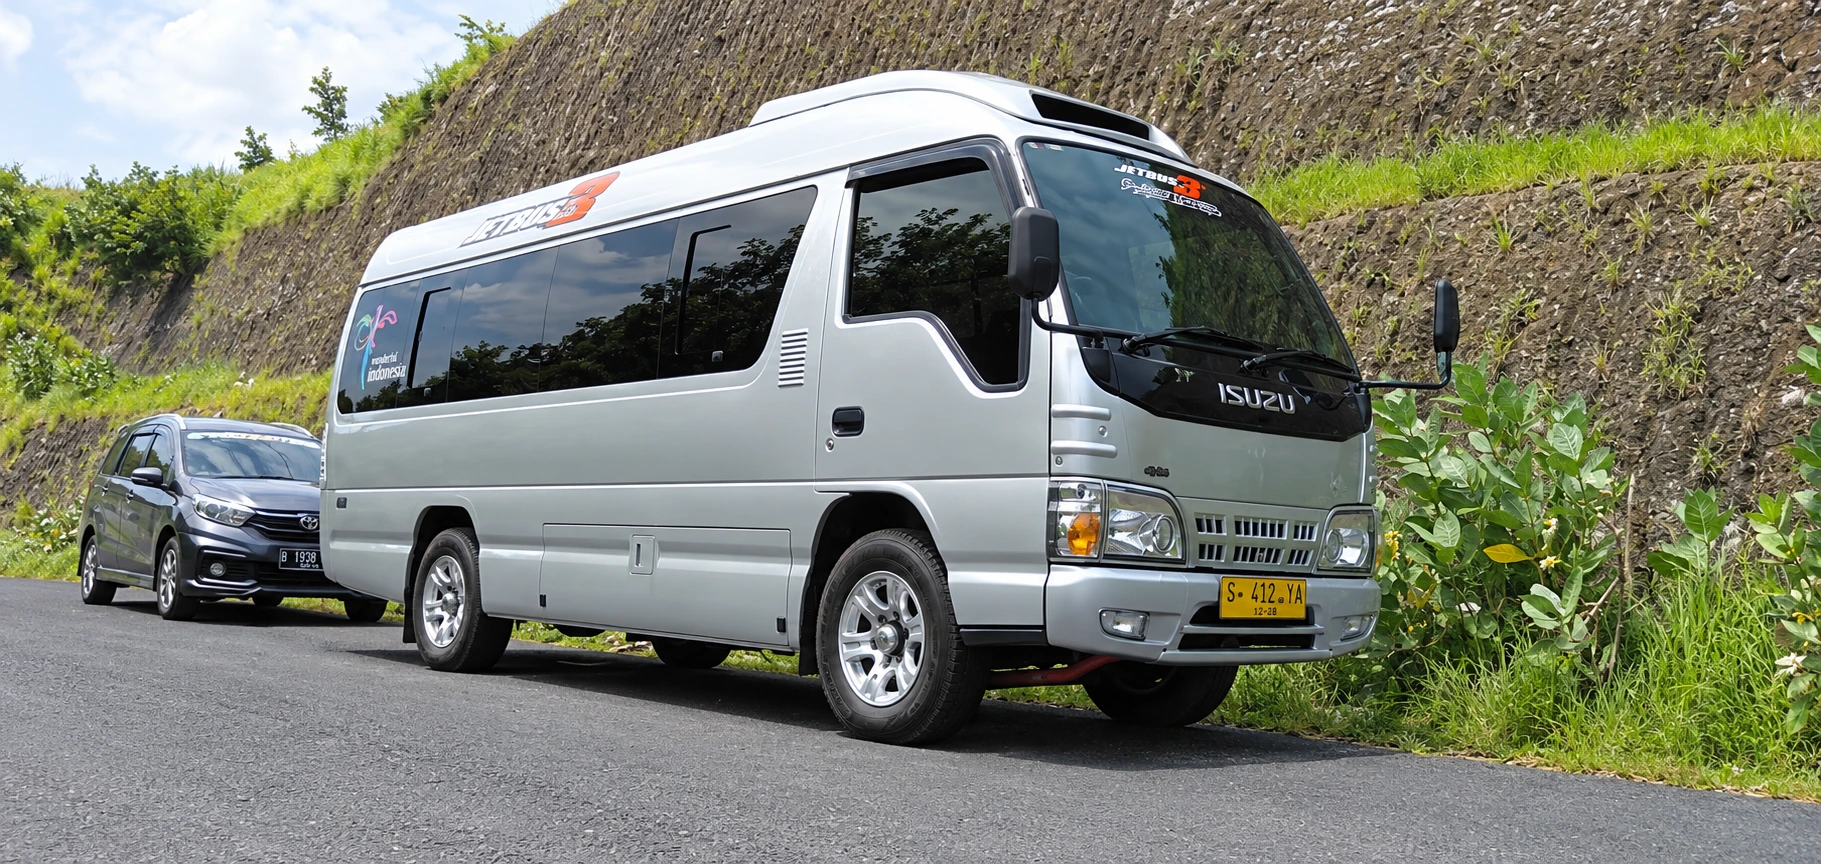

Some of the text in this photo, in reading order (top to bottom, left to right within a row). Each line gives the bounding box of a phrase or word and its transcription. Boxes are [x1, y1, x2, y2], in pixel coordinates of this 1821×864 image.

[367, 362, 407, 382] indonesia
[1218, 382, 1296, 415] ISUZU
[281, 551, 317, 564] B 1938
[1226, 581, 1303, 604] S 412 YA
